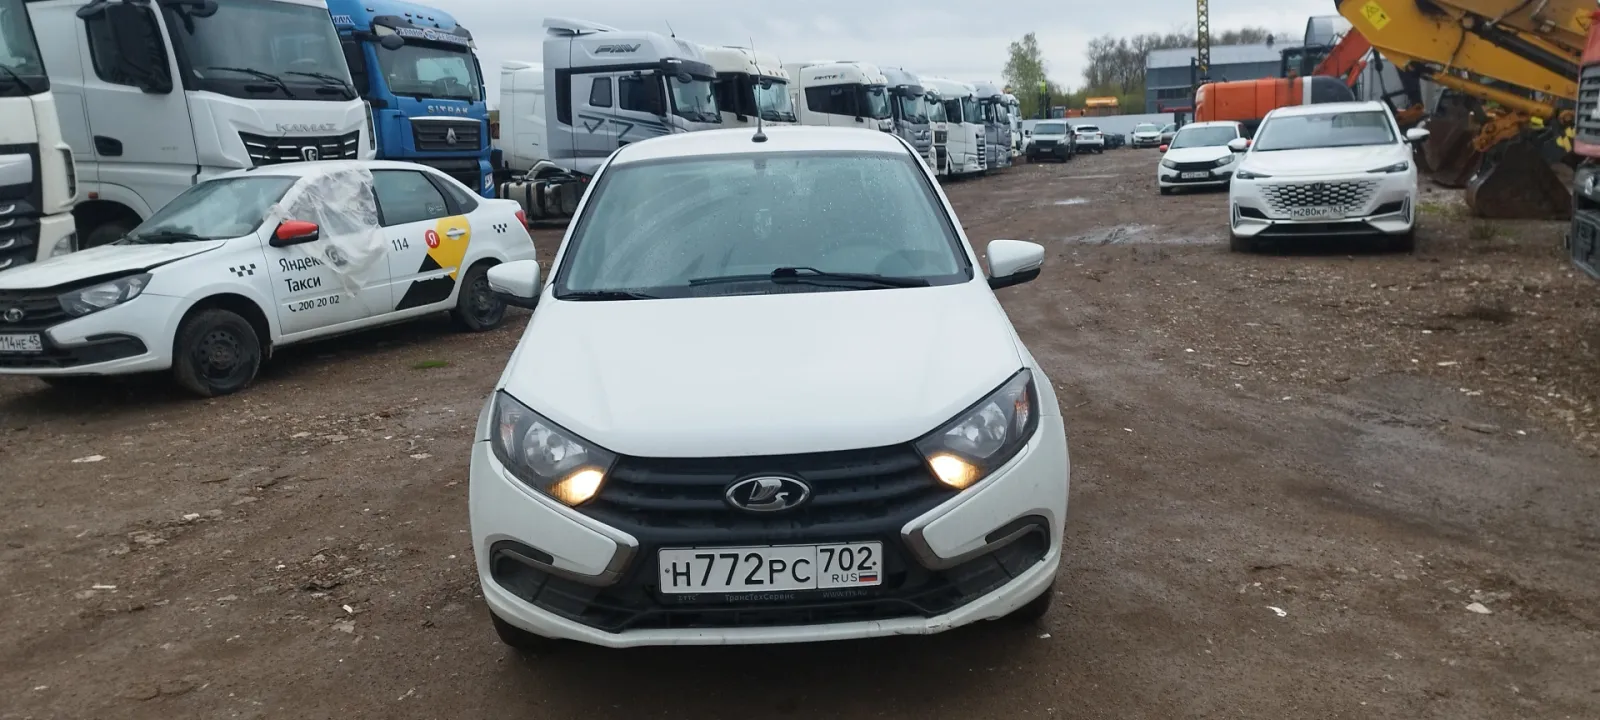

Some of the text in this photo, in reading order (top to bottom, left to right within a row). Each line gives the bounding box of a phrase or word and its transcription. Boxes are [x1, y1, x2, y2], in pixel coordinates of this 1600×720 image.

[427, 105, 469, 115] SITRAK
[275, 123, 337, 132] KAMAZ
[391, 237, 410, 252] 114
[284, 276, 322, 293] Такси
[298, 294, 340, 312] 200 20 02
[831, 573, 858, 583] RUS
